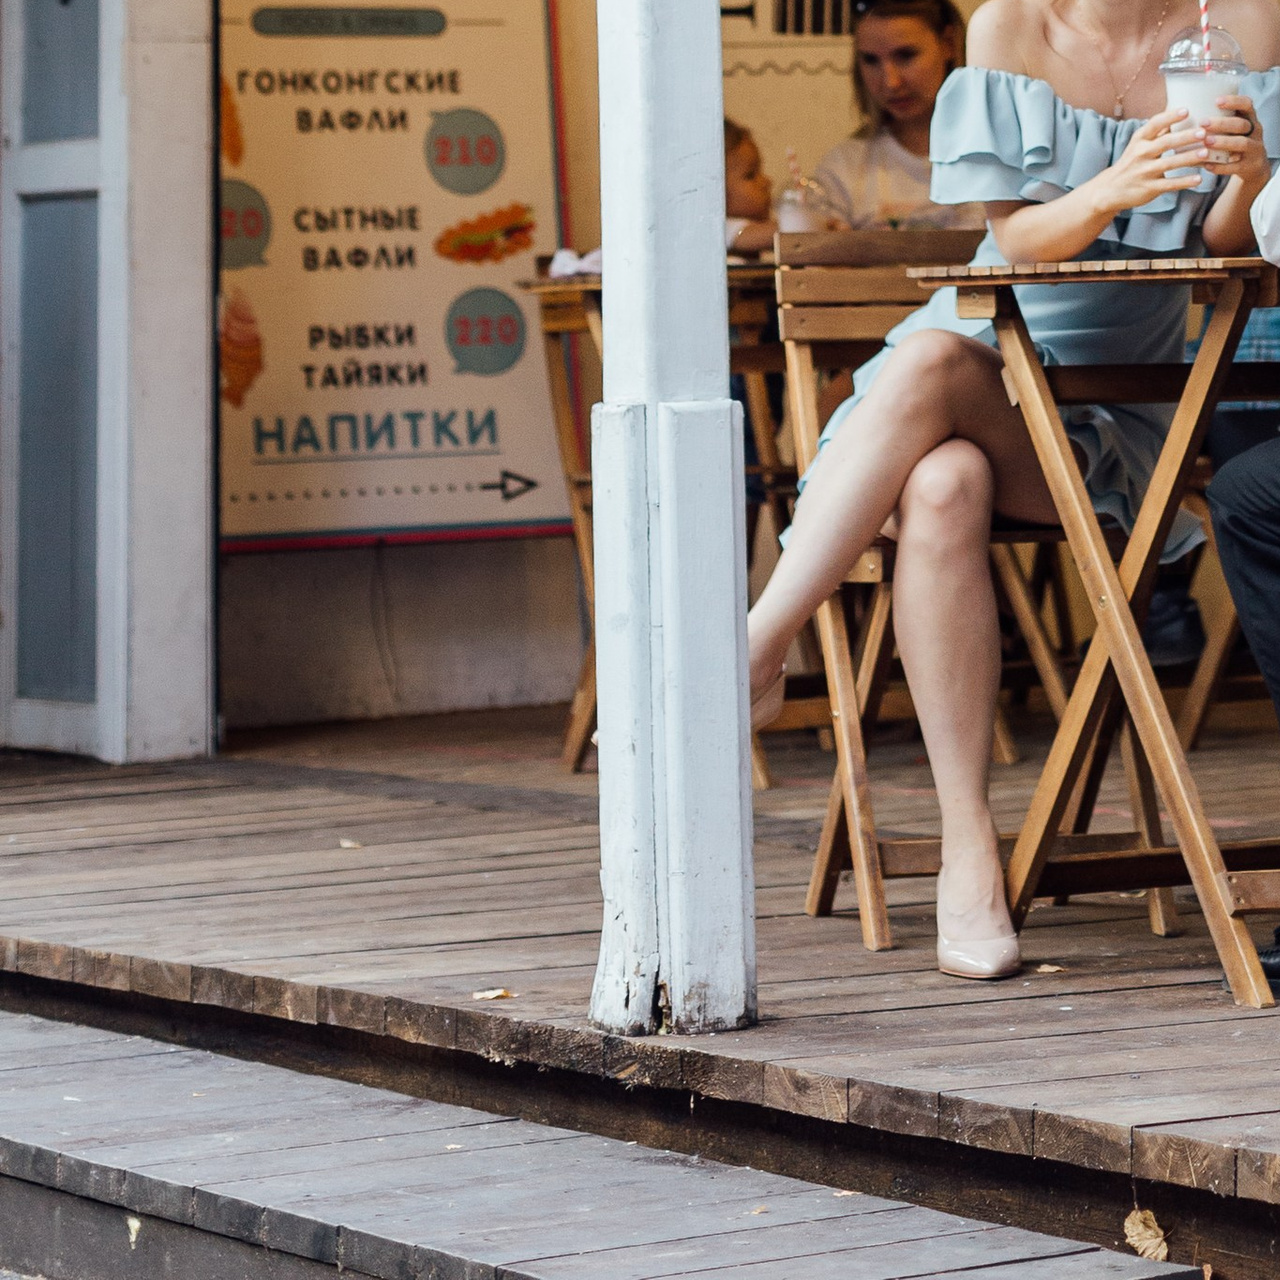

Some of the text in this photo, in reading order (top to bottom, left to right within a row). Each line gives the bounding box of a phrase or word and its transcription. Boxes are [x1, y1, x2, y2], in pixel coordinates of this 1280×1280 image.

[236, 69, 461, 95] ГОНКОНГСКИЕ
[296, 107, 409, 133] ВАФЛИ
[434, 135, 497, 167] 210
[293, 206, 420, 233] СЫТНЫЕ
[302, 246, 417, 272] ВАФЛИ
[308, 323, 415, 350] РЫБКИ
[453, 314, 519, 347] 220
[302, 358, 429, 389] ТАЙЯКИ
[253, 408, 498, 455] НАПИТКИ
